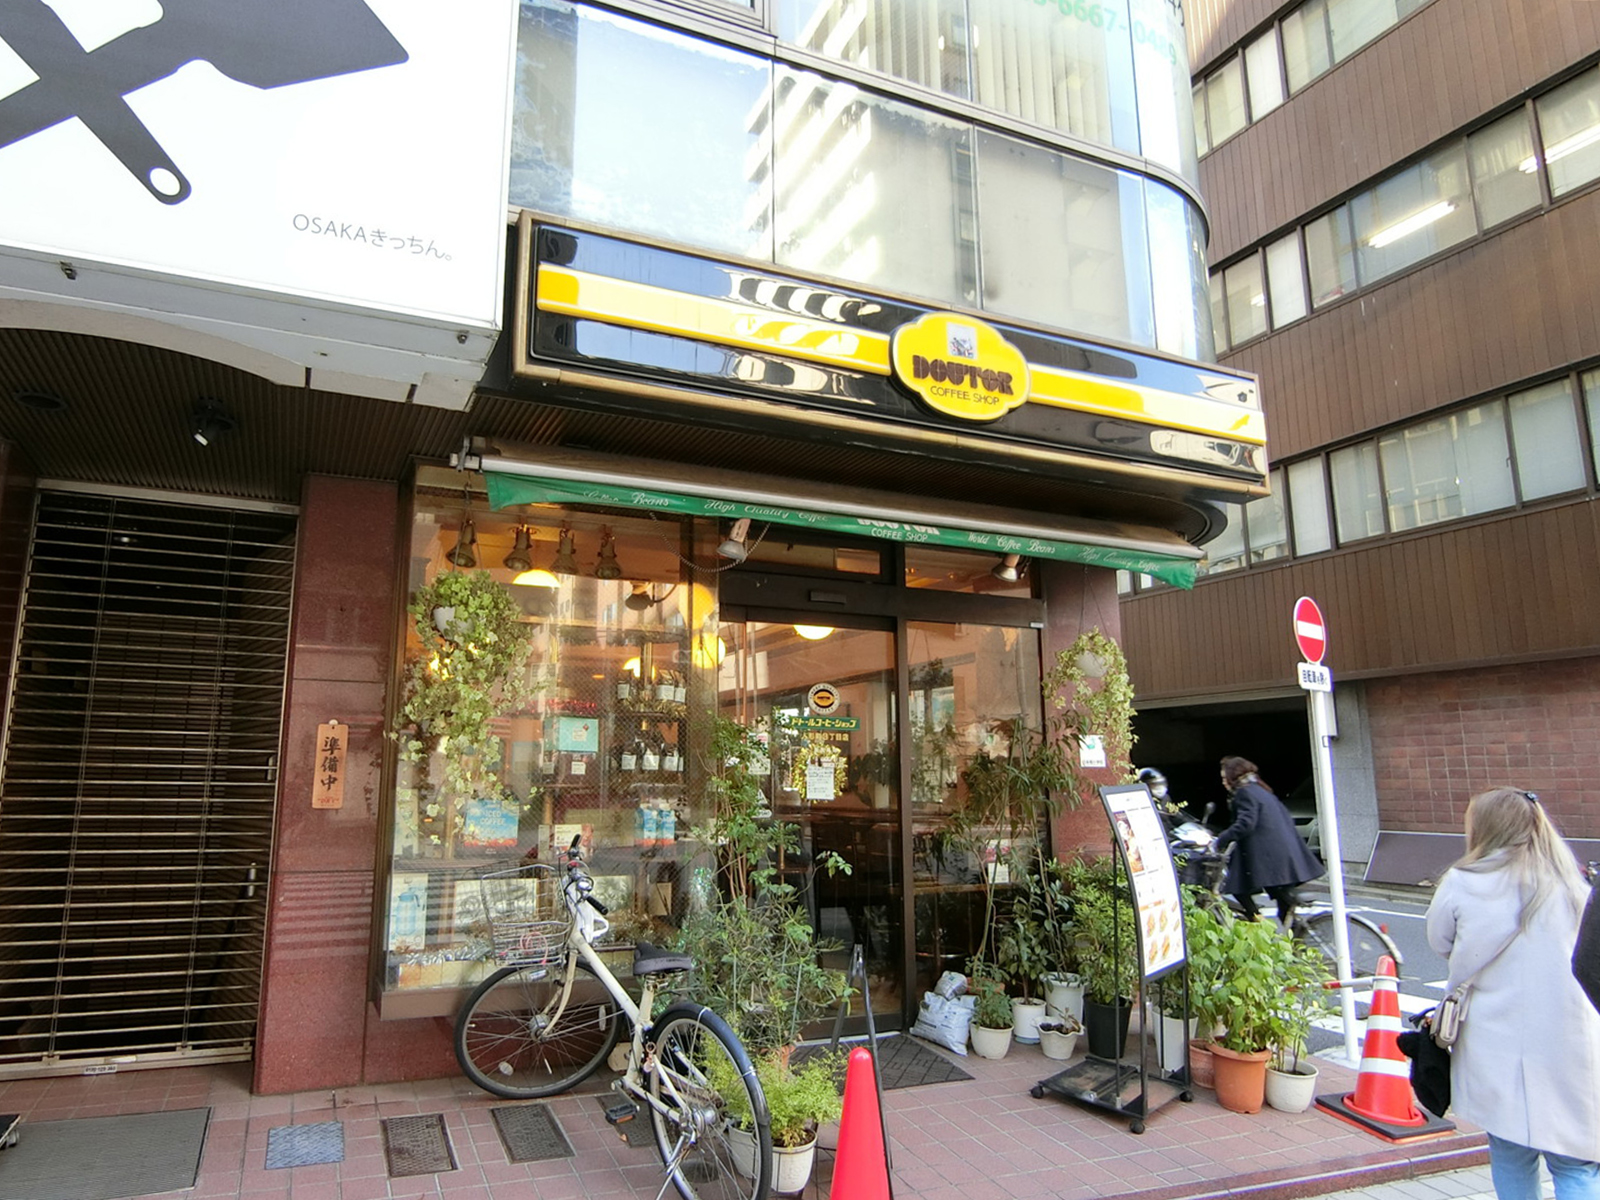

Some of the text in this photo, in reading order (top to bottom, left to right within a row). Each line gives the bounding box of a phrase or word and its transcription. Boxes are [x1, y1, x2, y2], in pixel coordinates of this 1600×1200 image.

[293, 213, 452, 261] OSAKAきっちん。
[912, 354, 1014, 395] DOUTOR
[930, 385, 1000, 406] COFFEE SHOP
[631, 491, 669, 507] Beans
[704, 499, 736, 513] High
[871, 527, 928, 543] COFFEE SHOP
[996, 535, 1022, 552] Coffee
[1027, 539, 1056, 554] Beans
[321, 736, 341, 792] 準備中
